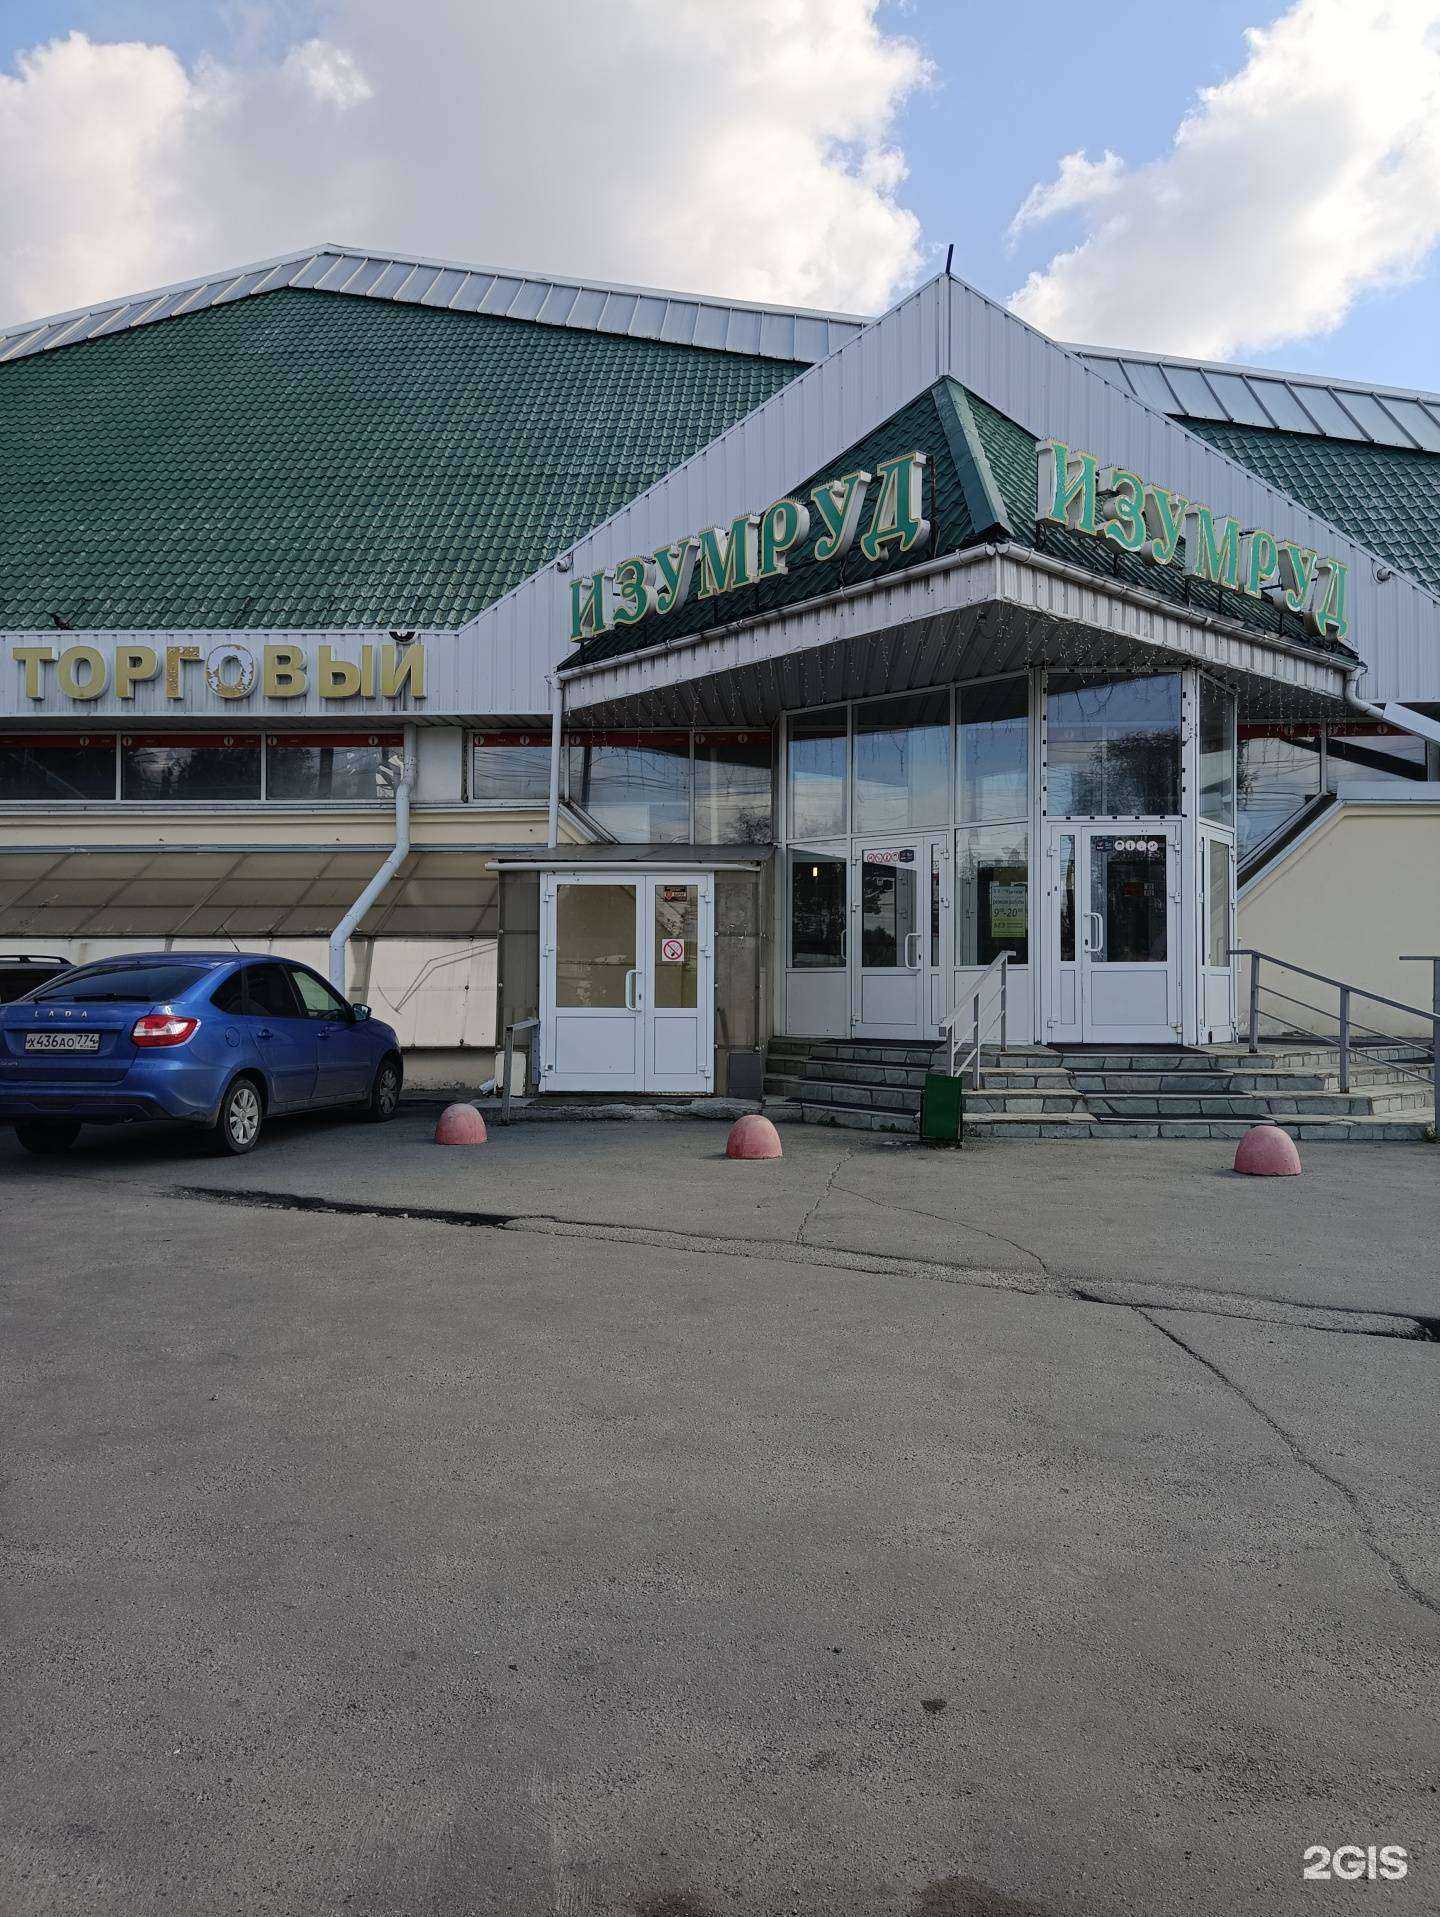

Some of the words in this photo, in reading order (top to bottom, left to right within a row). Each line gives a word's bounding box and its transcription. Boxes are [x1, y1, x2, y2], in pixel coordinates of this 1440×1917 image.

[569, 451, 930, 642] ИЗУМРУД
[1037, 440, 1348, 641] ИЗУМРУД
[12, 631, 427, 700] ТОРГОВЫЙ
[34, 1010, 88, 1018] LADA
